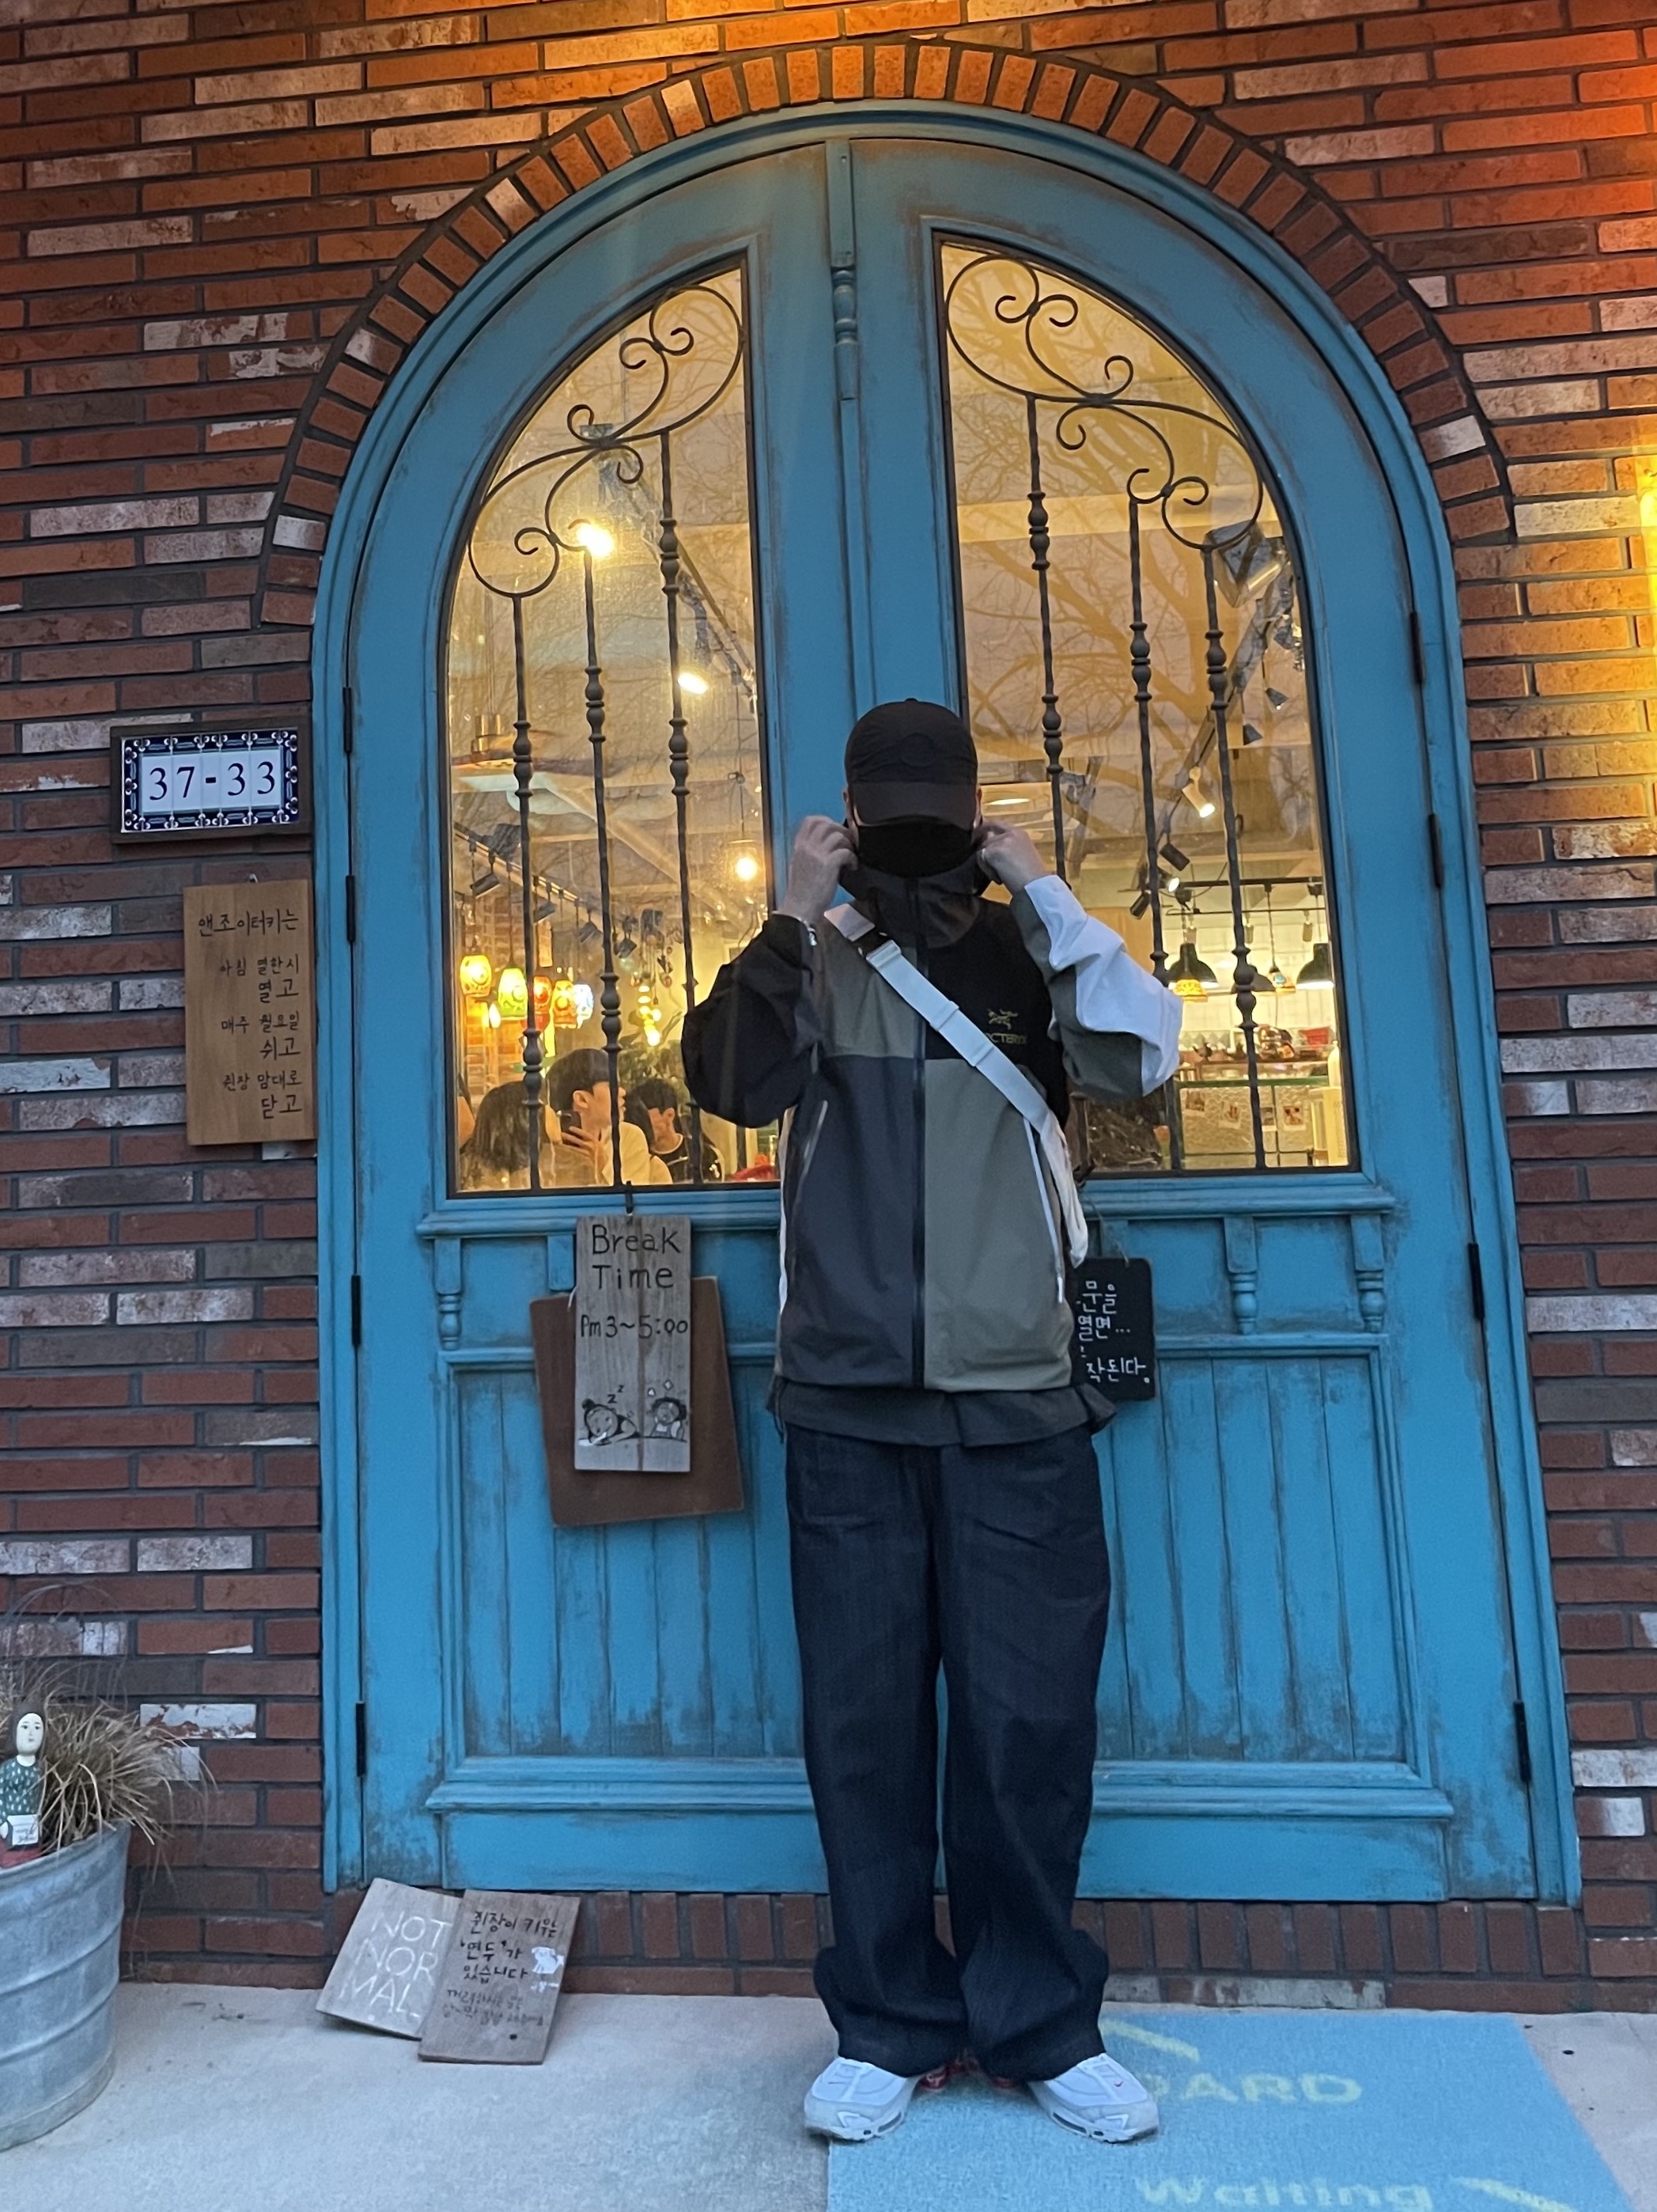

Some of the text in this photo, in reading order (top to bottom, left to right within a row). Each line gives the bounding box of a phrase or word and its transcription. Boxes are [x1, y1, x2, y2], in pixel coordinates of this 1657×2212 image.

[149, 760, 276, 801] 37-33
[198, 907, 300, 937] 앤조이터키는
[220, 953, 300, 978] 아침 열한시
[258, 978, 300, 1004] 열고
[221, 1009, 300, 1035] 매주 월요일
[259, 1036, 302, 1061] 쉬고
[222, 1071, 250, 1092] 쥔장
[261, 1093, 303, 1120] 닫고
[591, 1263, 675, 1290] Time
[1082, 1279, 1118, 1315] 문을
[370, 1911, 454, 1950] NOT
[354, 1938, 437, 1987] NOR
[463, 1964, 529, 1985] 있습니다
[339, 1971, 422, 2017] MAL
[1136, 2176, 1434, 2212] Waiting
